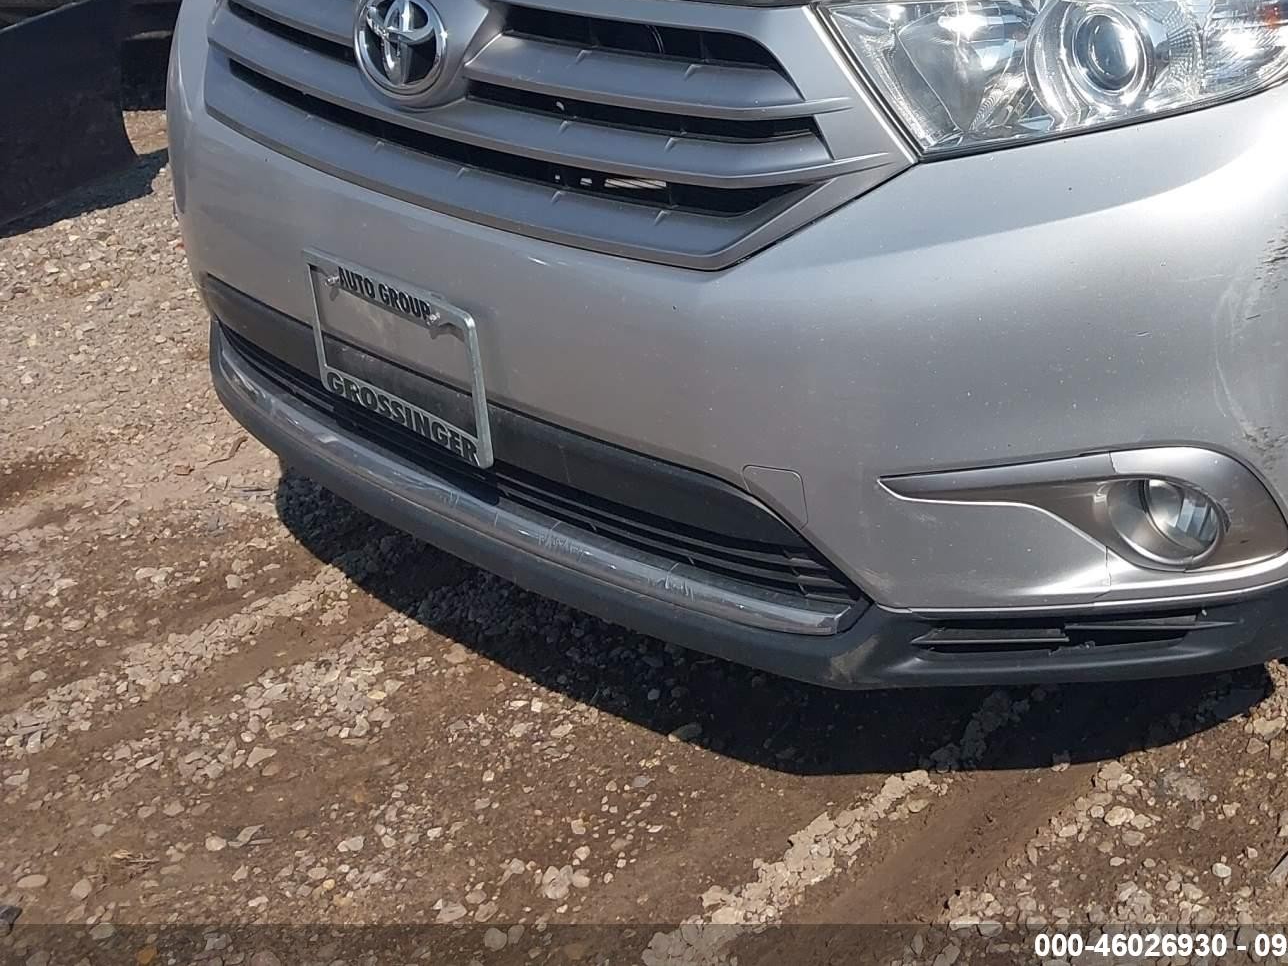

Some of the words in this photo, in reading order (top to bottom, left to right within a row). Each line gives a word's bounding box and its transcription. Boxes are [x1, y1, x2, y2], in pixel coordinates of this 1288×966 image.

[337, 265, 376, 300] AUTO
[378, 283, 432, 322] GROUP
[326, 371, 480, 467] GROSSINGER
